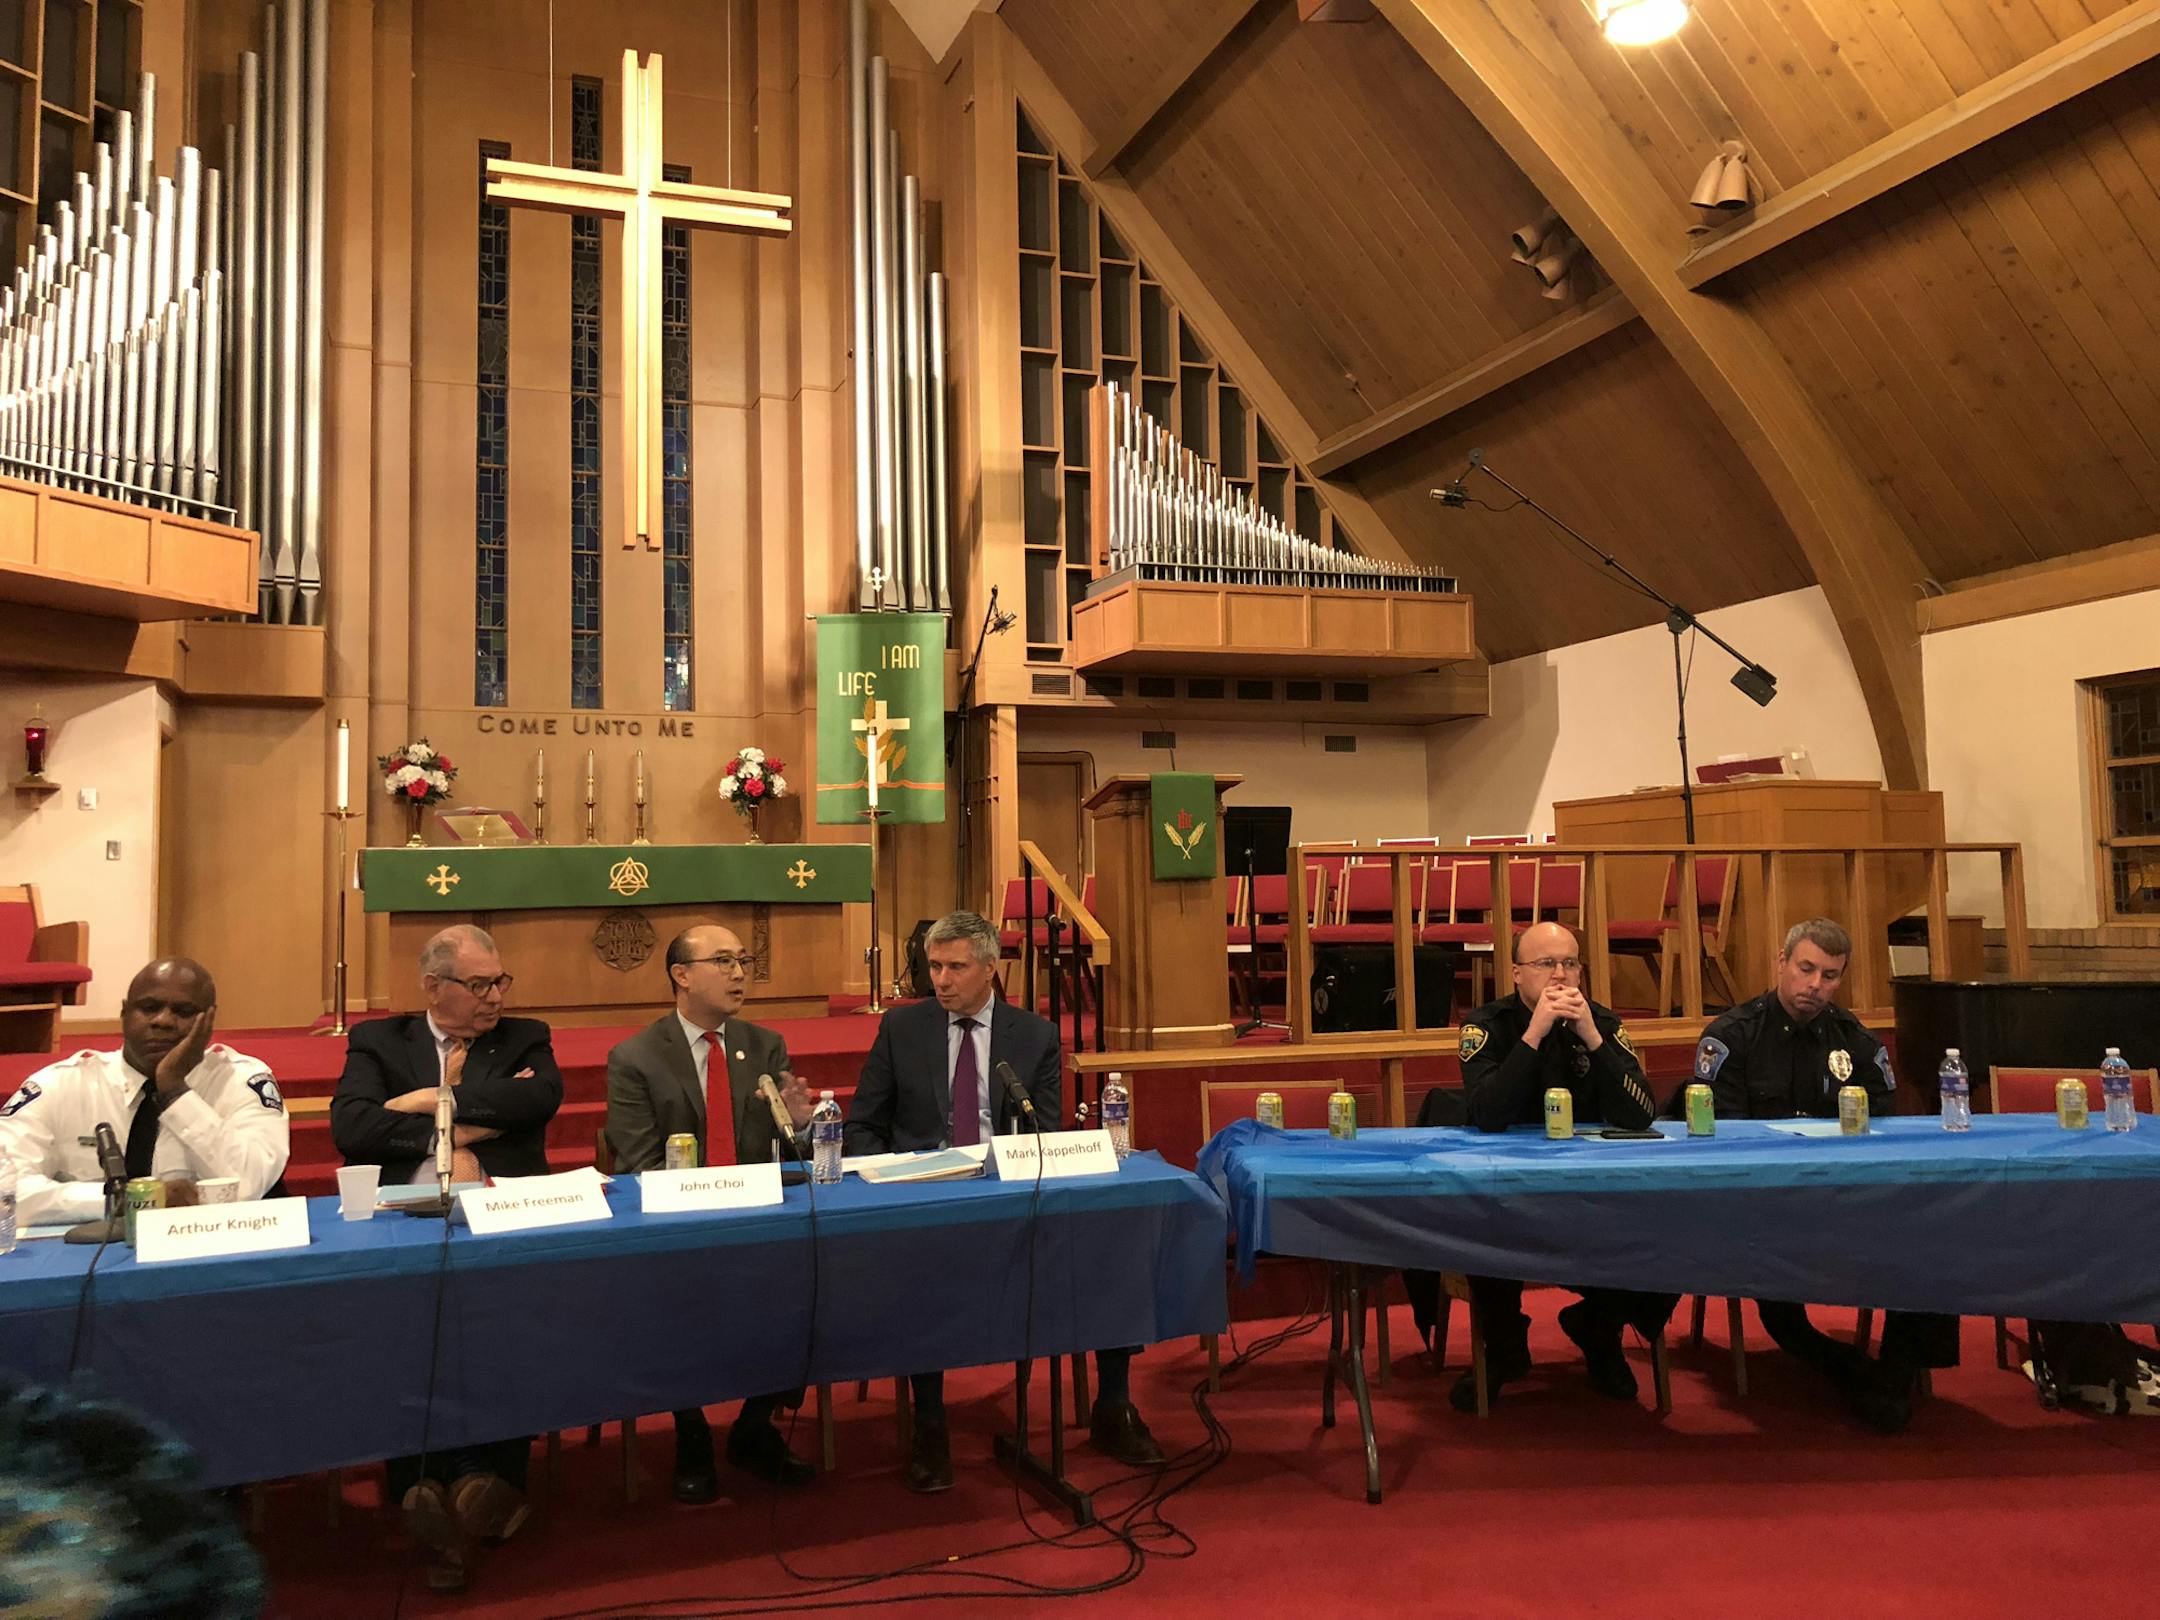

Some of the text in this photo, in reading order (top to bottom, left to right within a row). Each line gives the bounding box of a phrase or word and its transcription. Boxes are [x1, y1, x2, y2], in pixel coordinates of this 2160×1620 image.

[891, 644, 920, 669] AM
[838, 671, 877, 696] LIFE
[658, 718, 693, 737] ME
[1006, 1141, 1102, 1160] Mark Kappelhoff
[680, 1178, 745, 1193] John Choi
[485, 1192, 584, 1213] Mike Freeman
[167, 1215, 278, 1235] Arthur Knight
